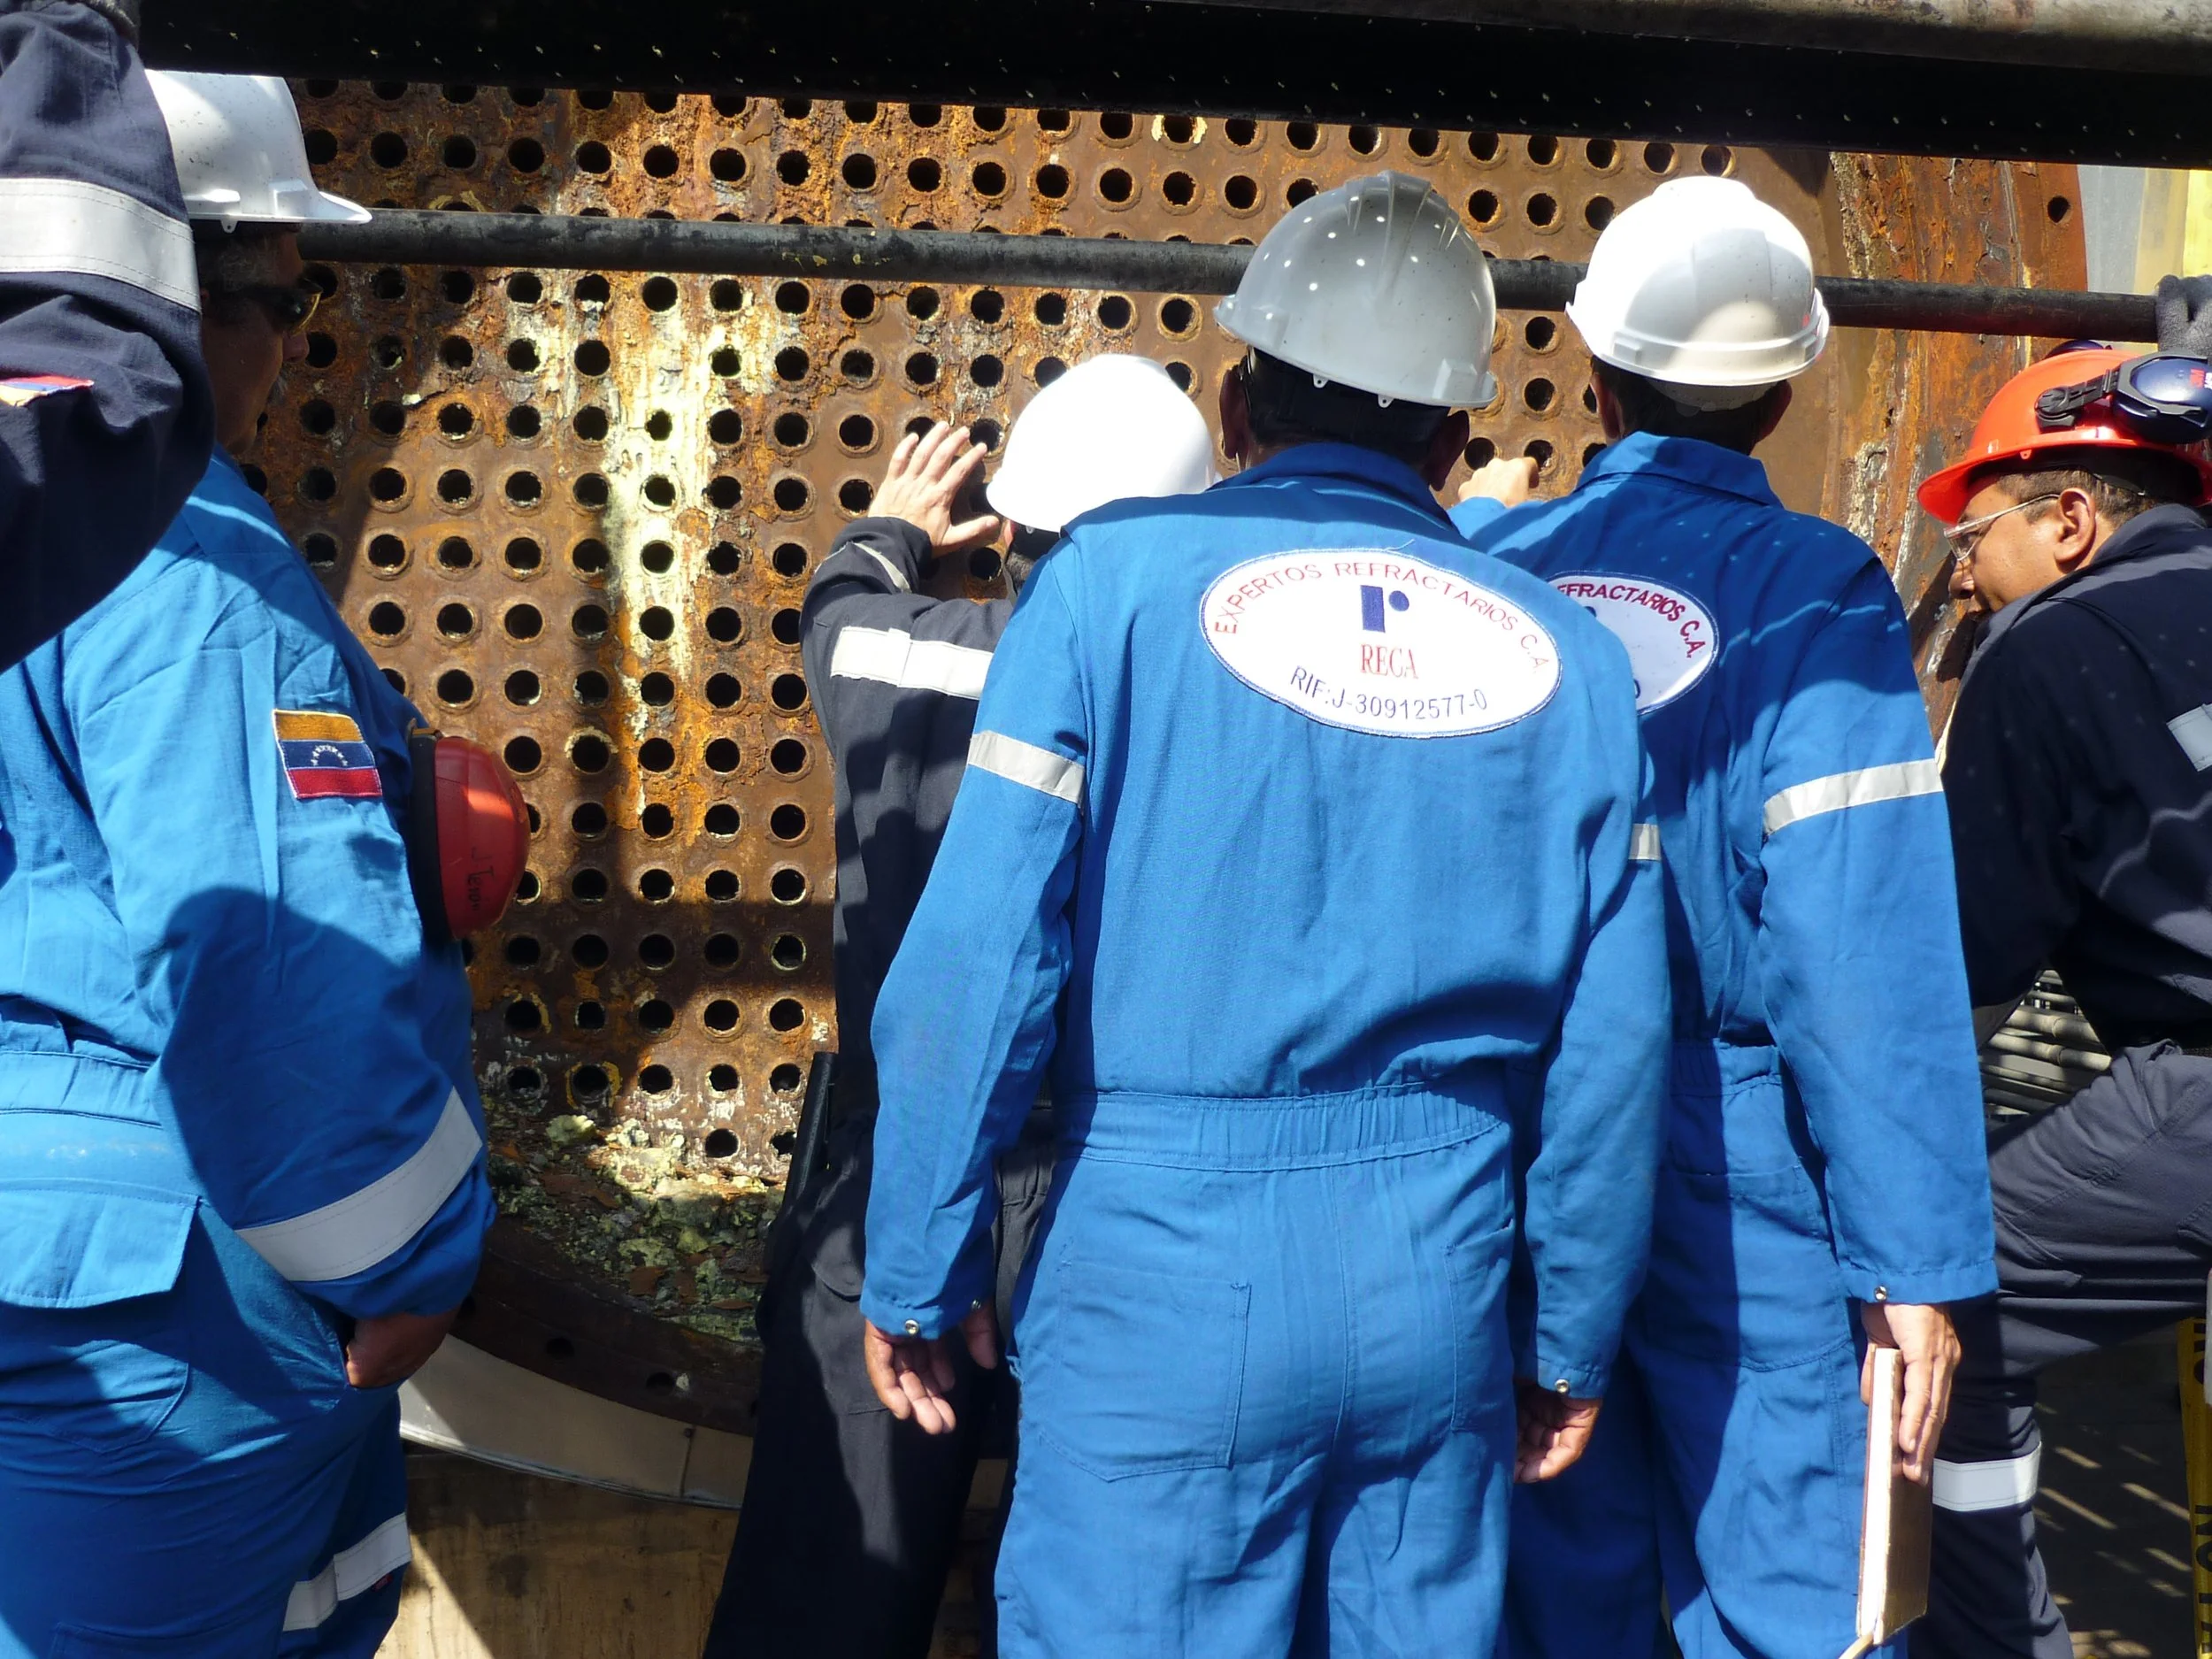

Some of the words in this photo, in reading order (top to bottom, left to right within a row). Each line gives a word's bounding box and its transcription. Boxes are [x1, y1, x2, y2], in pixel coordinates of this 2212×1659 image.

[1214, 564, 1323, 634] EXPERTOS
[1334, 562, 1518, 631] REFRACTARIOS
[1557, 582, 1686, 622] EFRACTARIOS
[1679, 619, 1707, 658] C.A.
[1360, 643, 1419, 680] RECA
